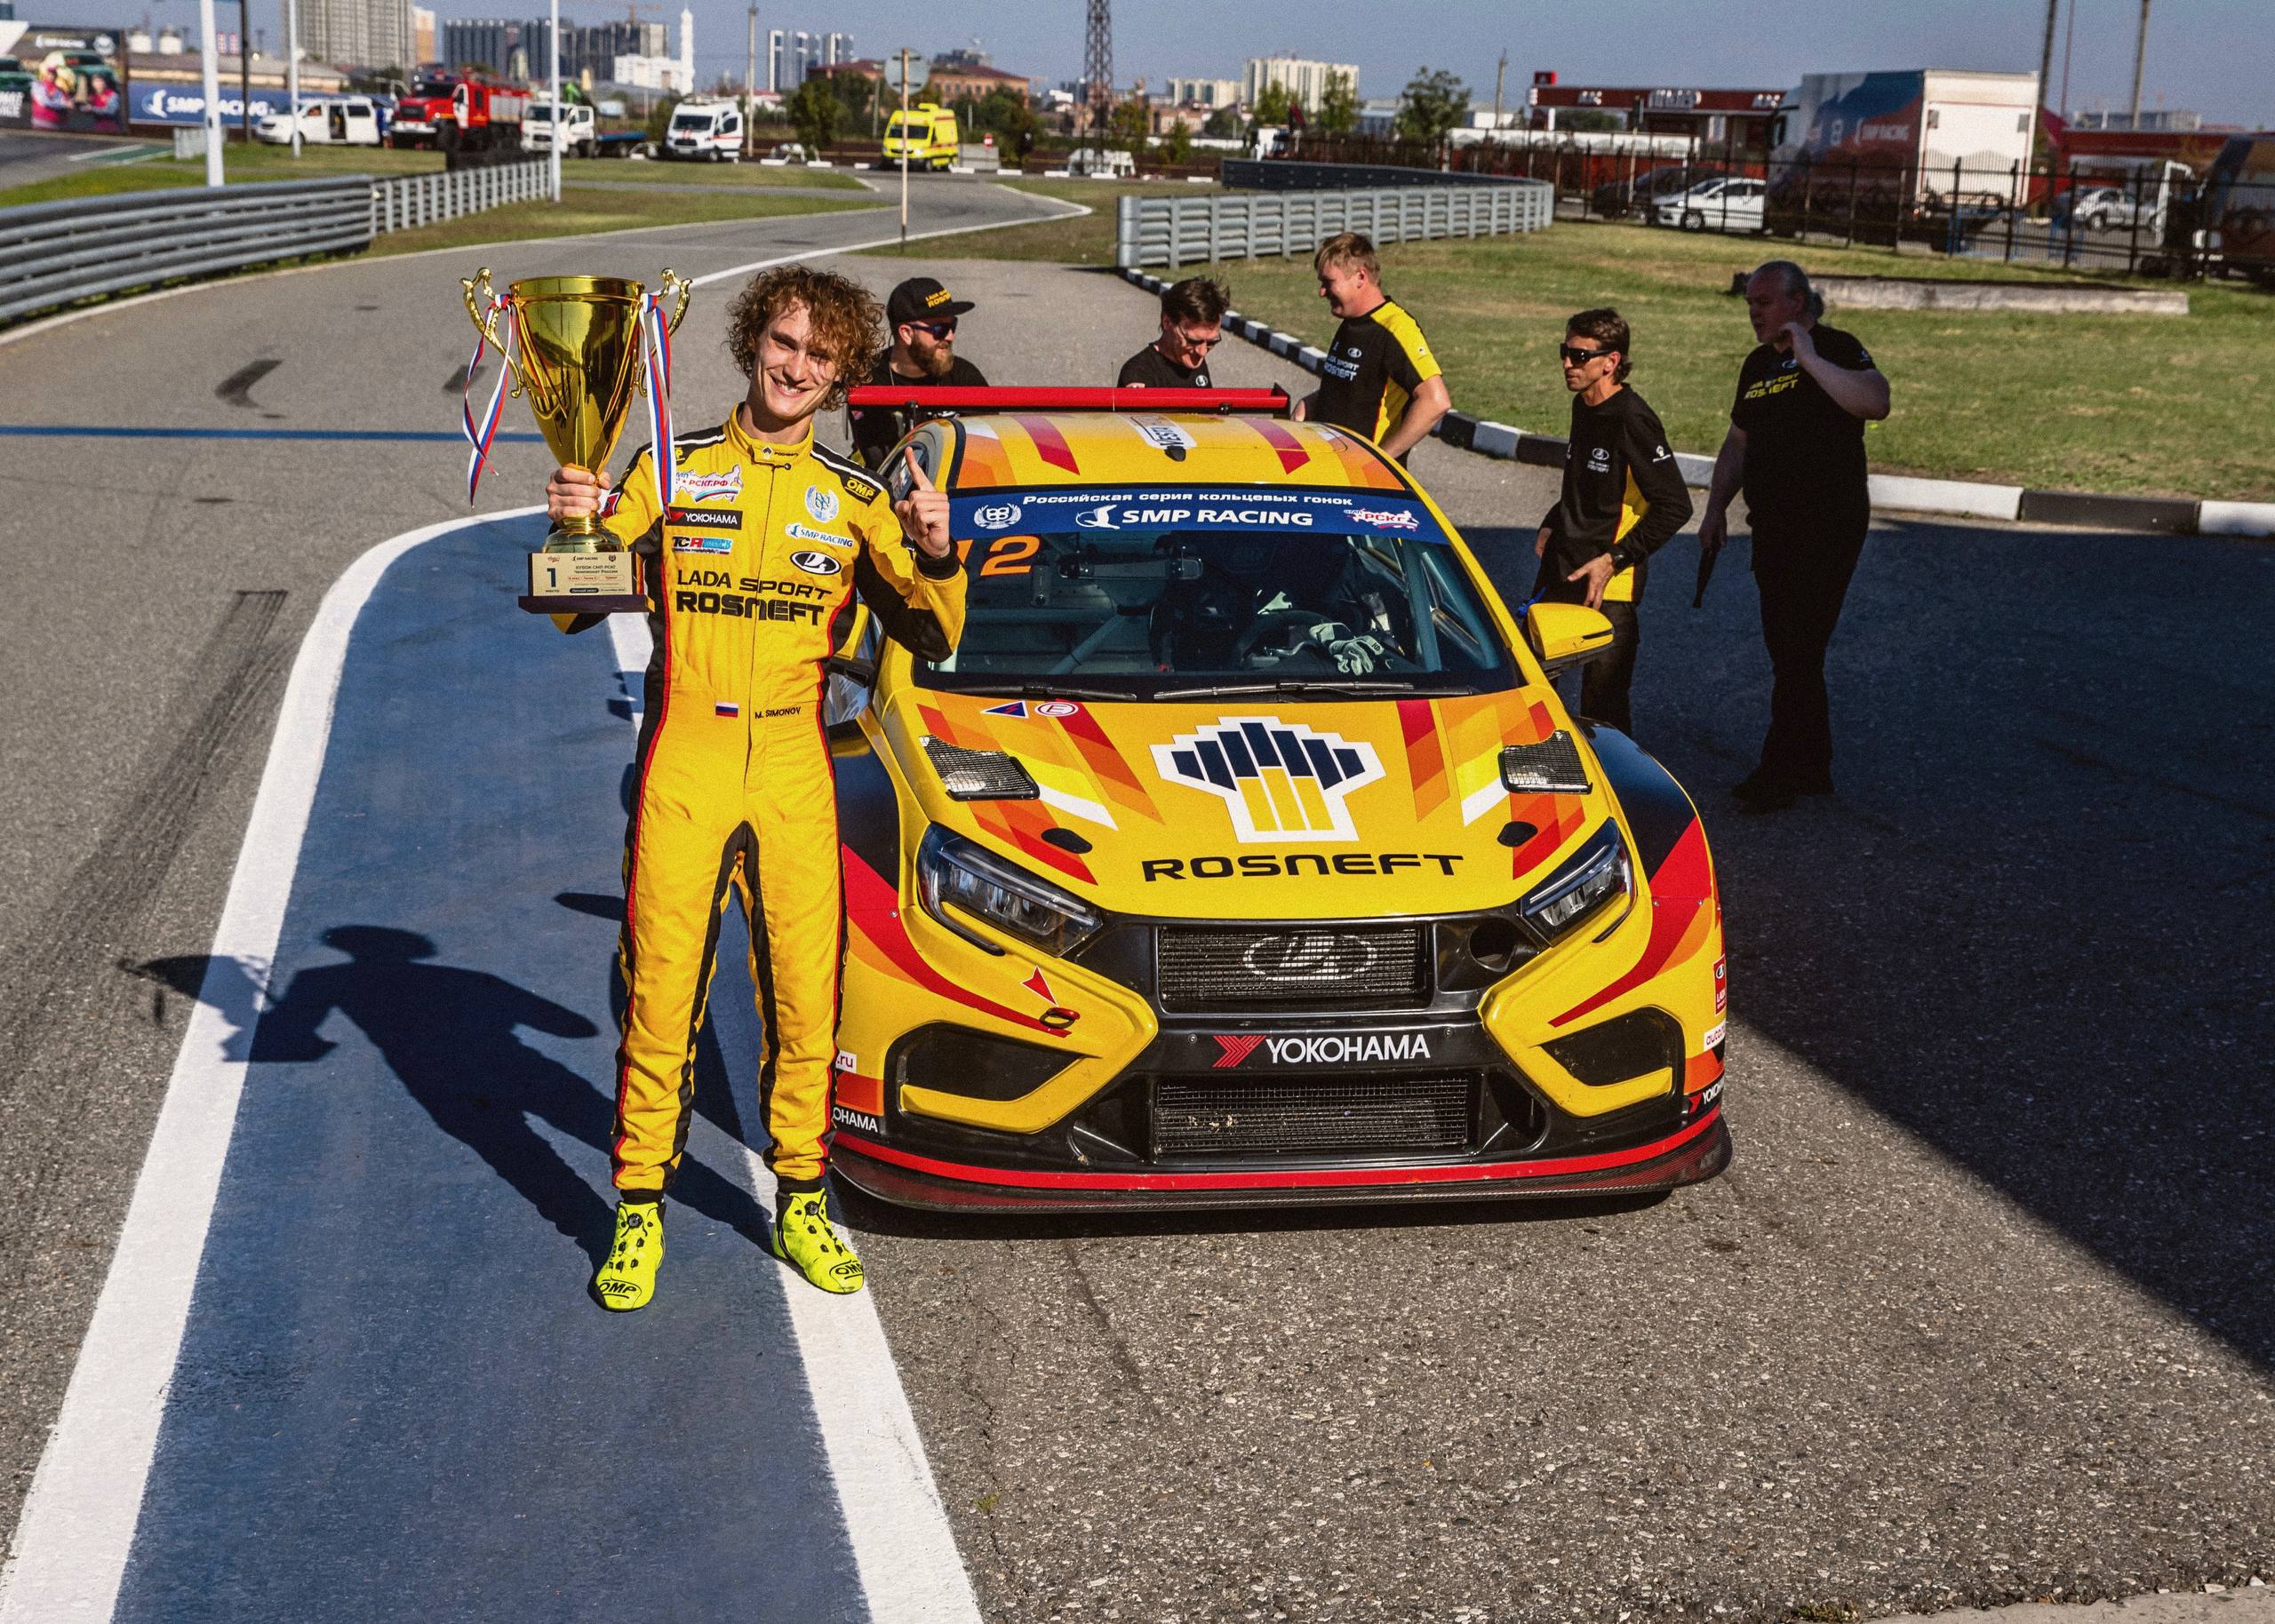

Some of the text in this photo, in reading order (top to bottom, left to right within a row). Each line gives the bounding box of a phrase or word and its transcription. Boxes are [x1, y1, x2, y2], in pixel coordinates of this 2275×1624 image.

[846, 481, 875, 498] OMP
[1023, 494, 1132, 505] Российская
[1199, 494, 1297, 503] кольцевых
[1304, 496, 1353, 506] гонок
[685, 513, 738, 524] YOKOHAMA
[1122, 509, 1313, 526] SMP RACING
[801, 529, 853, 547] SMP RACING
[547, 568, 556, 587] 1
[677, 569, 833, 600] LADA SPORT
[675, 591, 825, 626] ROSNEFT
[765, 706, 801, 718] SIMONOV
[1141, 853, 1464, 882] ROSNEFT
[1265, 1033, 1431, 1063] YOKOHAMA
[833, 1106, 878, 1133] OHAMA
[599, 1282, 637, 1294] OMP
